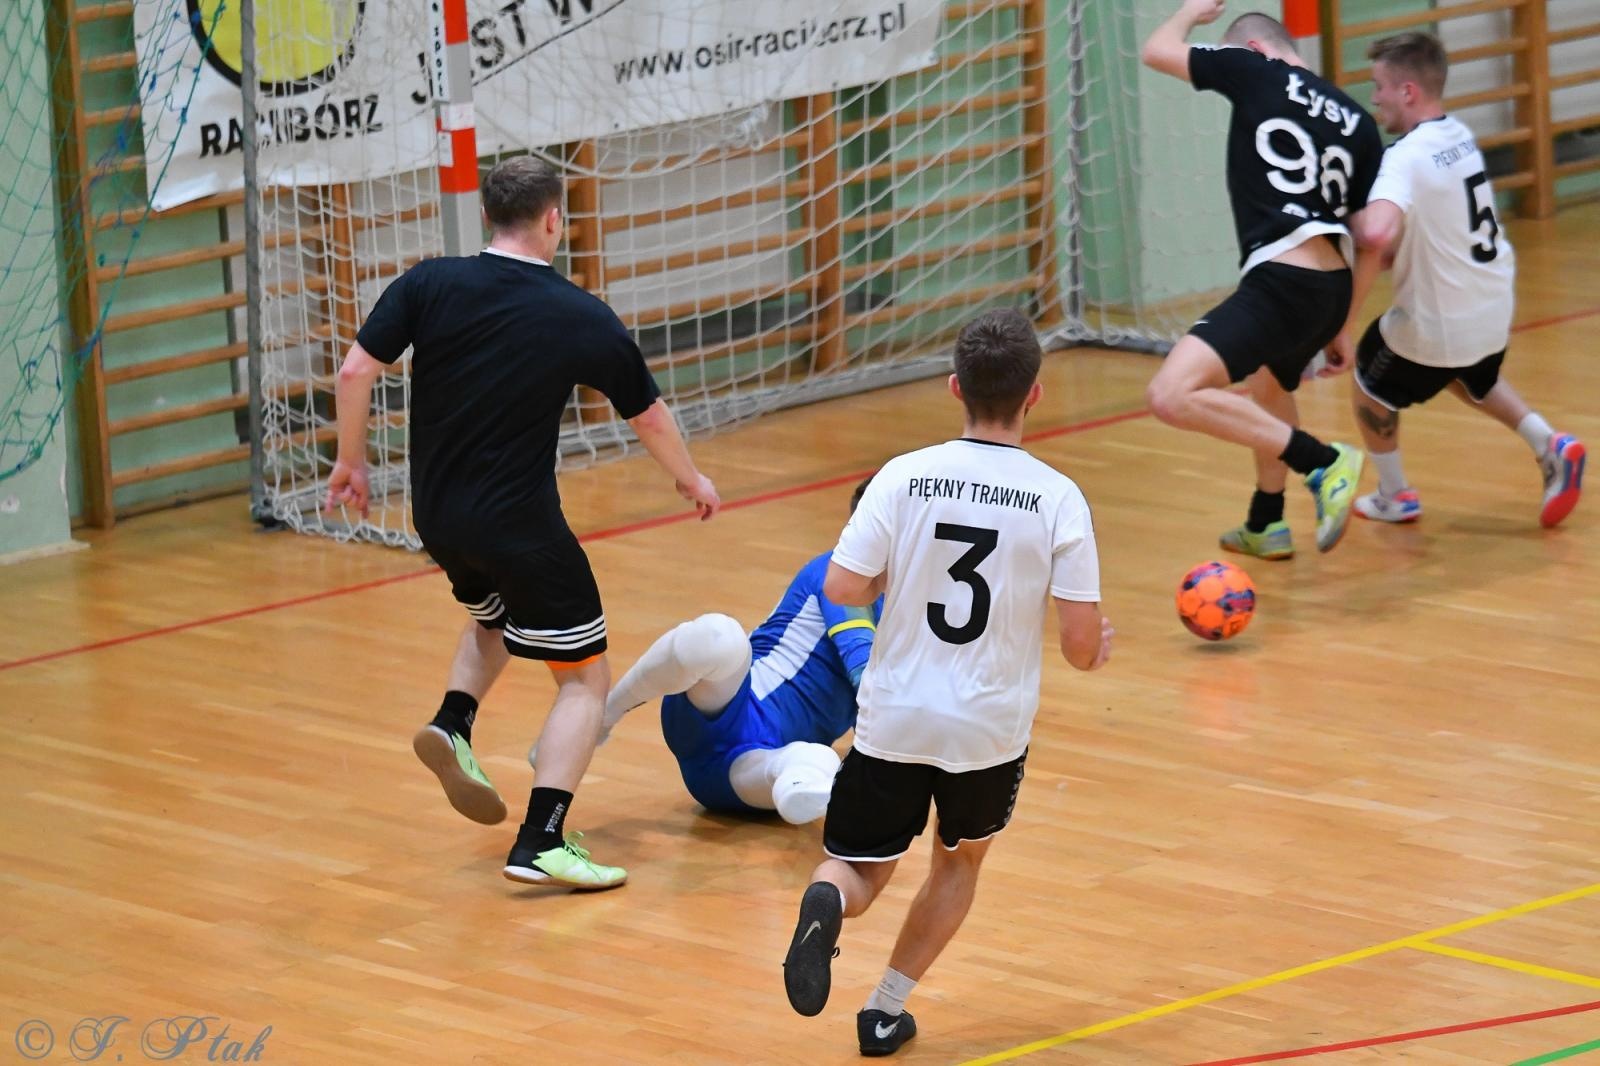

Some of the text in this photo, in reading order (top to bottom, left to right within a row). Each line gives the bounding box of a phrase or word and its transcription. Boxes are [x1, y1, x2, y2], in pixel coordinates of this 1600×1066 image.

[411, 0, 526, 105] JST
[1286, 73, 1361, 136] Łysy
[1463, 170, 1499, 264] 5
[908, 477, 1042, 513] PIĘKNY TRAWNIK
[926, 522, 999, 645] 3
